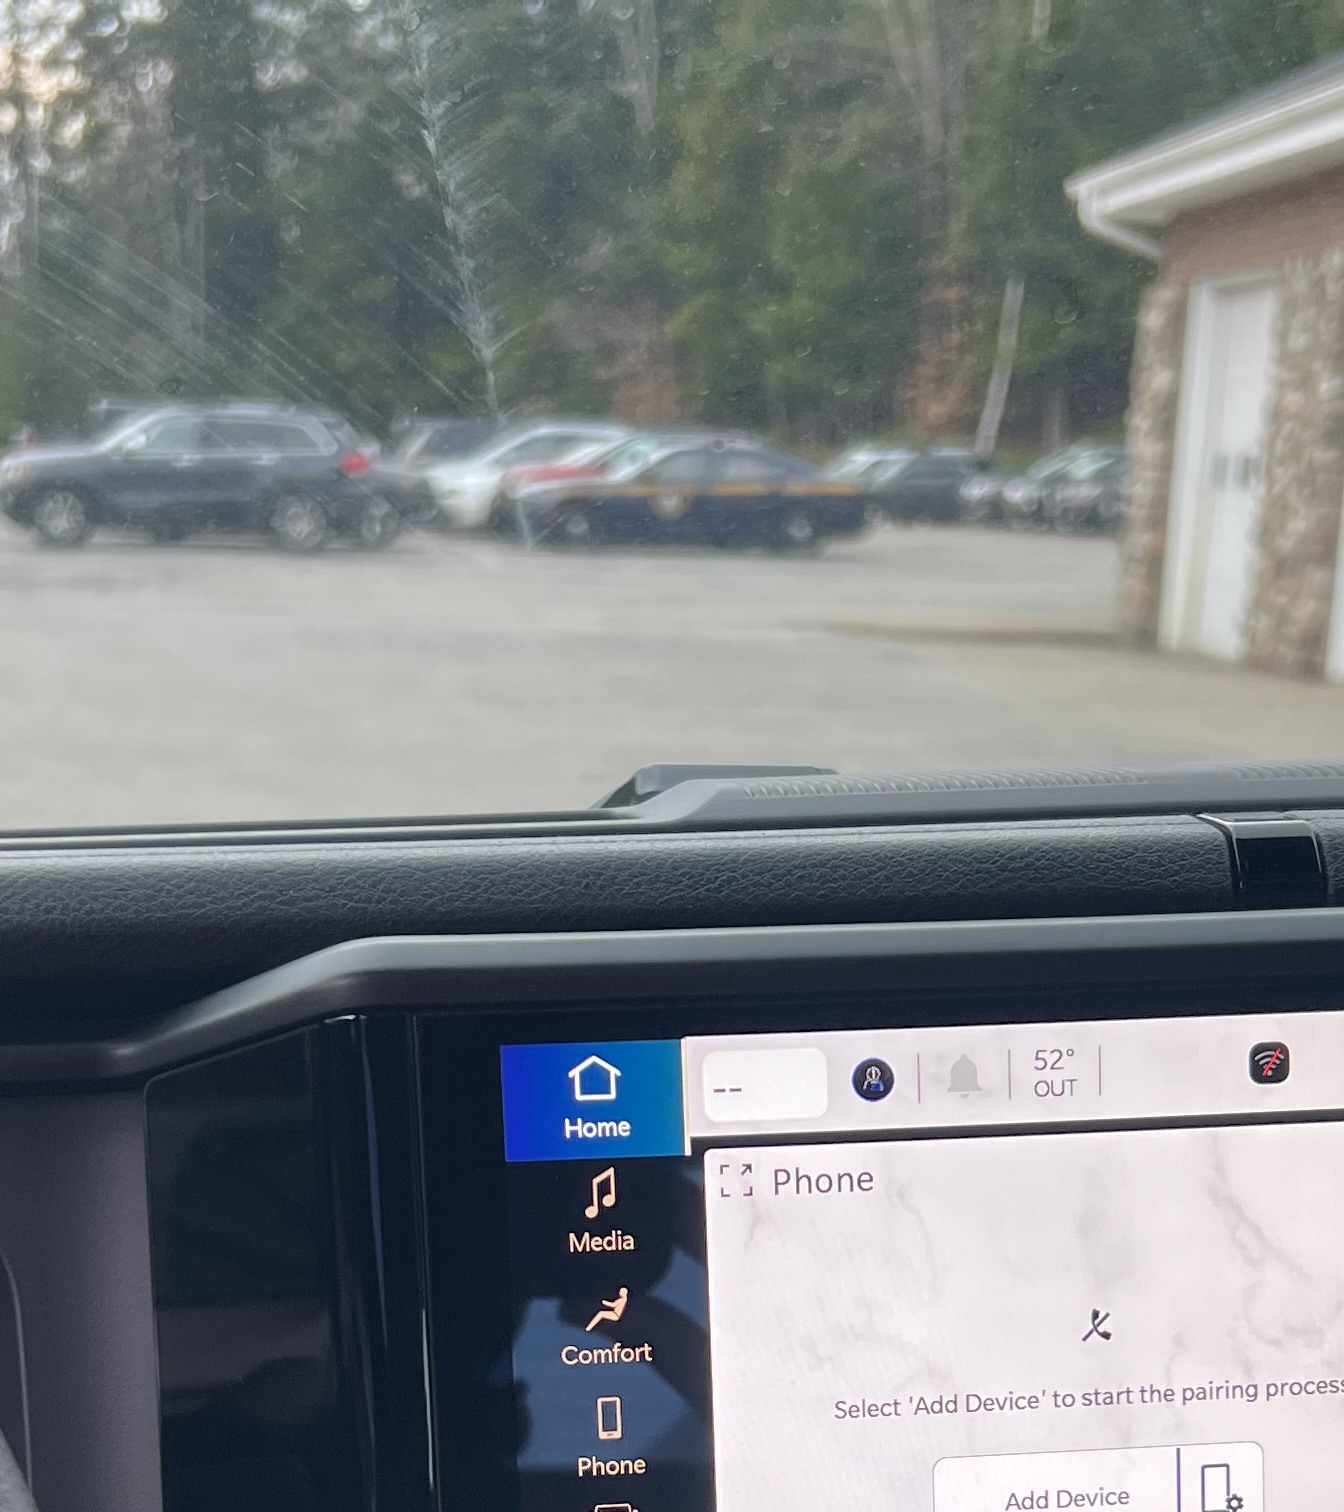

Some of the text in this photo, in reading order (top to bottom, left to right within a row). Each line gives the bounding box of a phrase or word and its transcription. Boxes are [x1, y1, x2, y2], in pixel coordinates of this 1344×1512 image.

[1033, 1048, 1075, 1071] 52°
[1034, 1079, 1078, 1098] OUT
[564, 1118, 631, 1139] Home
[773, 1166, 875, 1196] Phone
[567, 1231, 635, 1253] Media
[561, 1343, 653, 1366] Comfort
[834, 1398, 901, 1419] Select
[909, 1394, 958, 1415] 'Add
[965, 1389, 1046, 1412] Device'
[1052, 1390, 1076, 1408] to
[1081, 1386, 1134, 1407] start
[1139, 1384, 1175, 1404] the
[1182, 1380, 1257, 1405] pairing
[577, 1456, 647, 1477] Phone
[1005, 1487, 1130, 1511] Add Device
